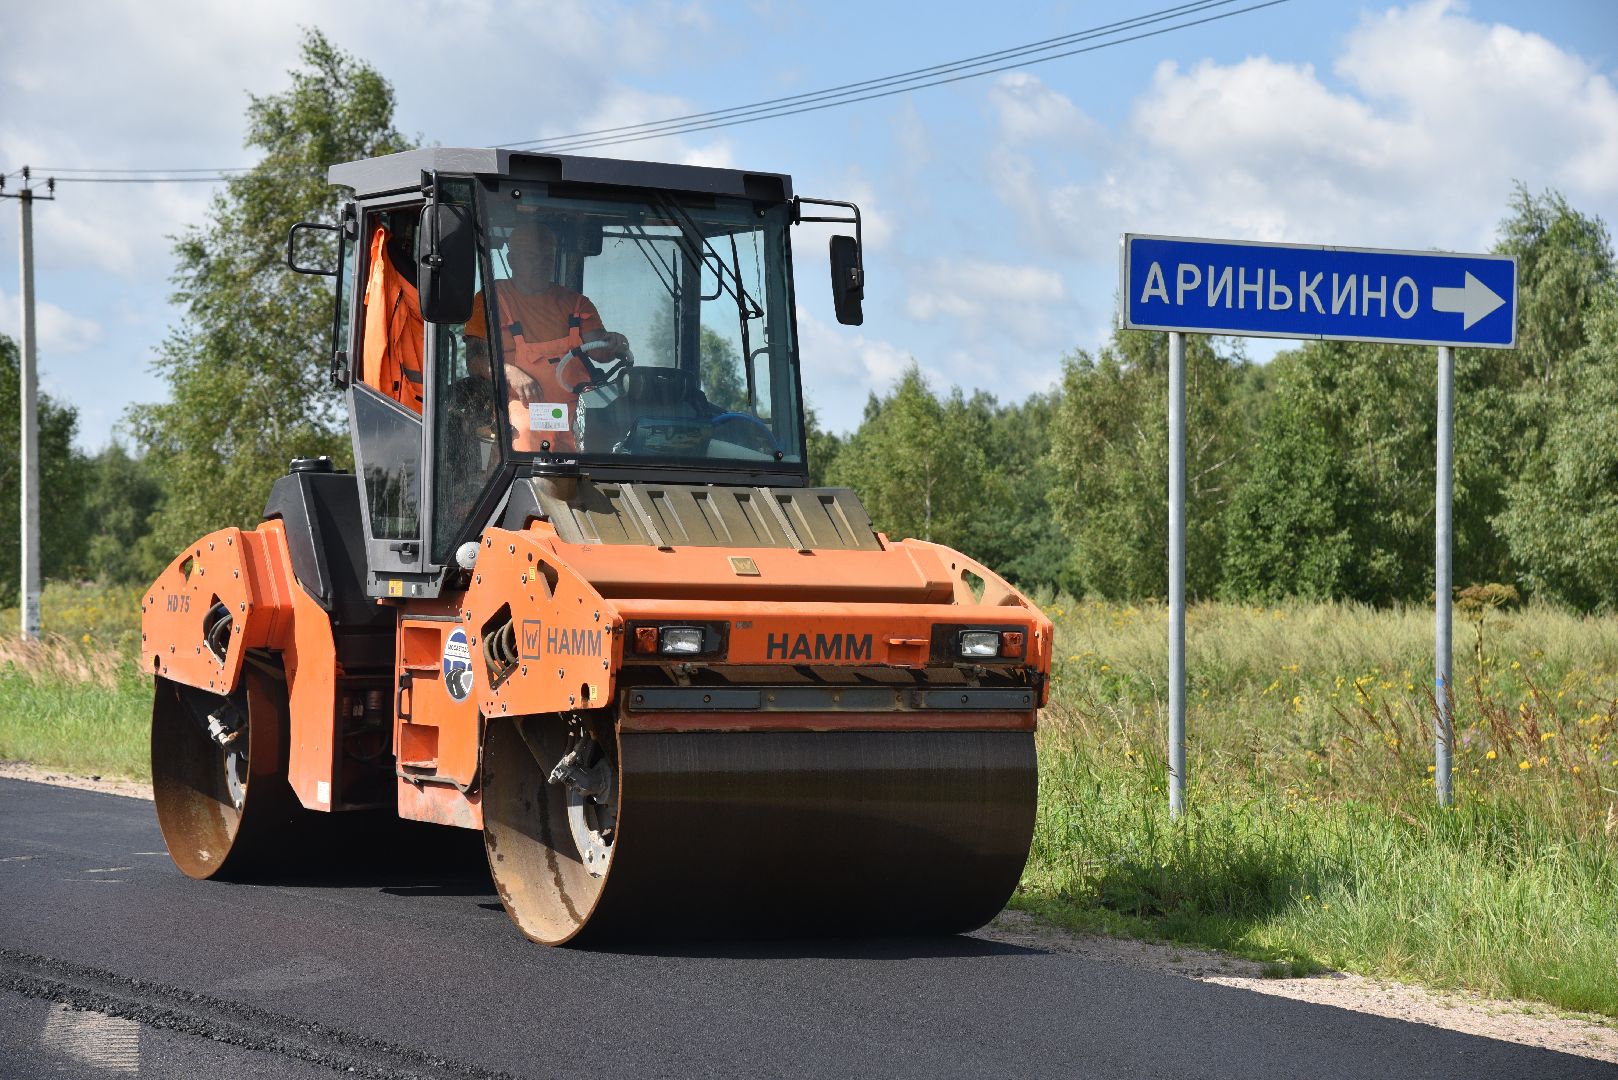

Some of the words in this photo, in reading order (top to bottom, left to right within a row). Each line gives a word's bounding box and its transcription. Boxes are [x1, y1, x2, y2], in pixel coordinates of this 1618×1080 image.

[1141, 261, 1419, 319] АРИНЬКИНО
[167, 594, 179, 612] HD
[180, 595, 190, 612] 75
[547, 627, 602, 656] HAMM
[767, 633, 873, 660] HAMM
